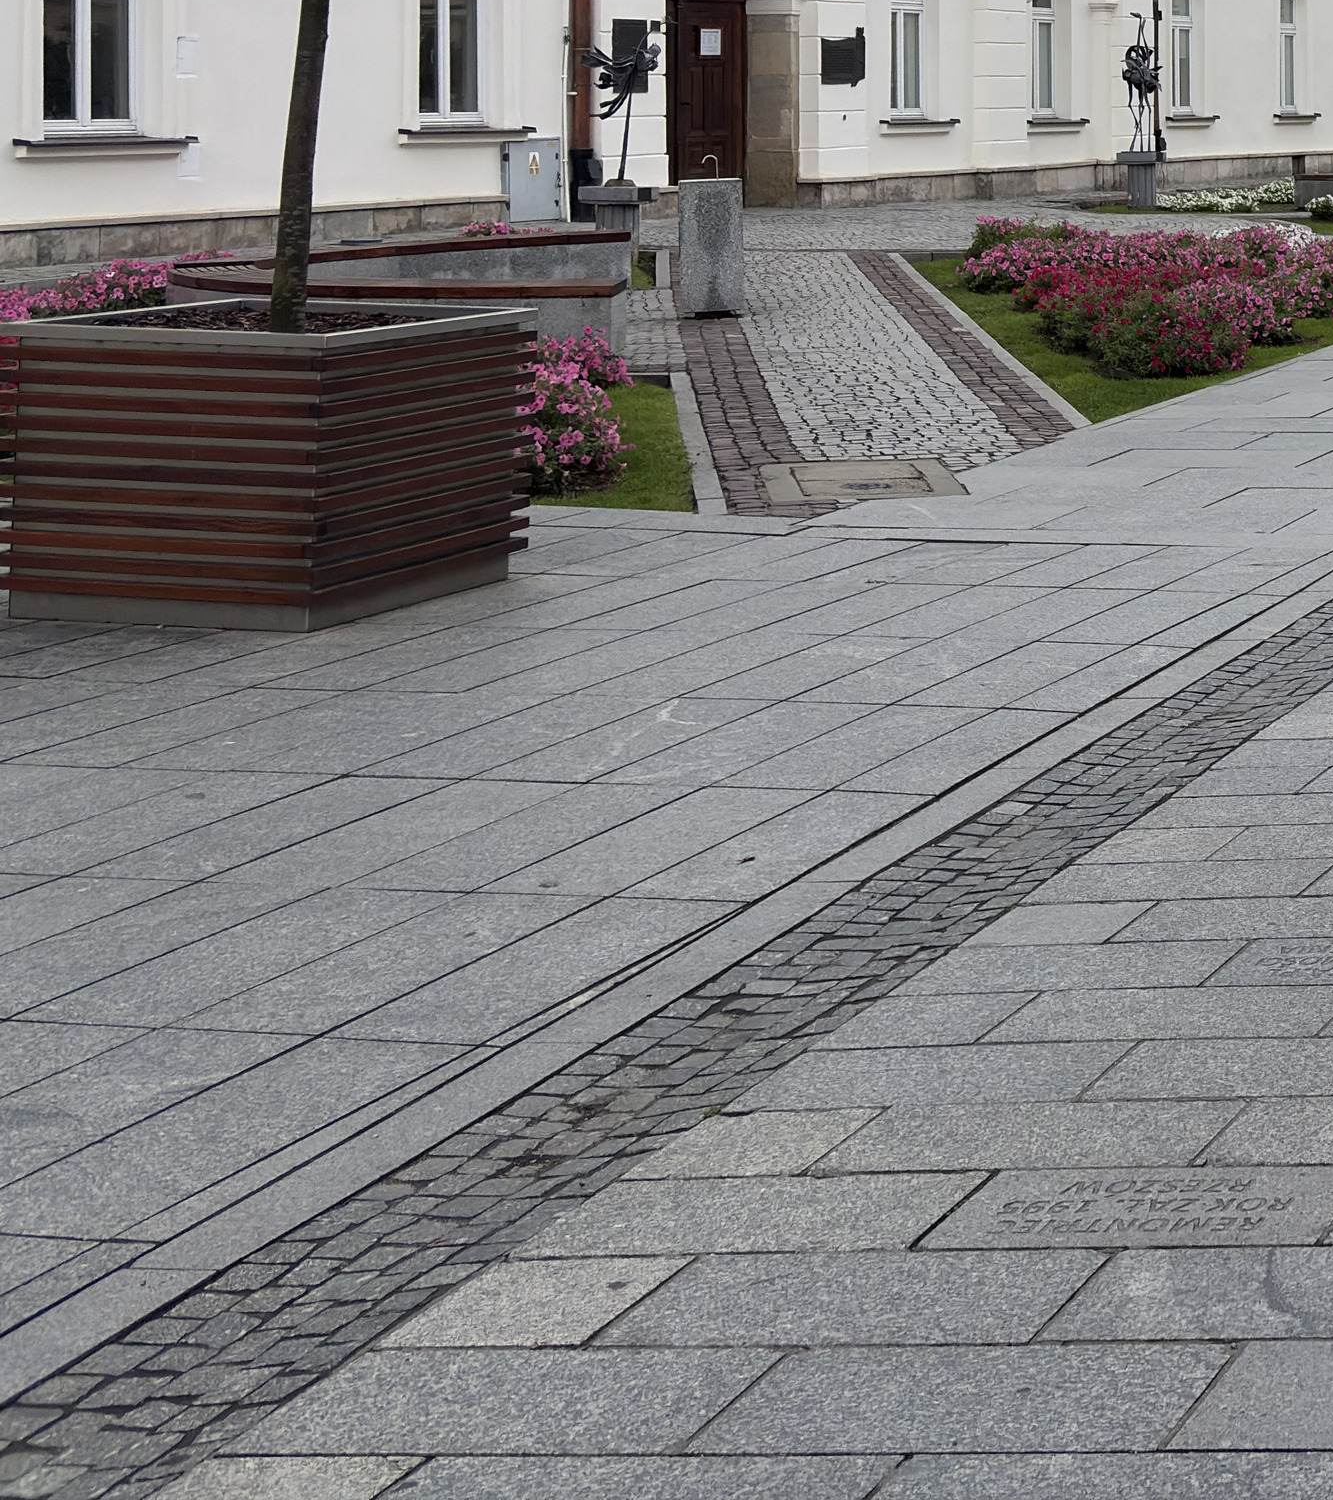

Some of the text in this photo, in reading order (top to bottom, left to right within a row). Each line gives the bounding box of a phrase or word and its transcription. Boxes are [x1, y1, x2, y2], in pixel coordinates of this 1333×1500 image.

[1058, 1179, 1257, 1198] RZESZÓW
[996, 1197, 1294, 1215] ROK ZAŁ. 1995
